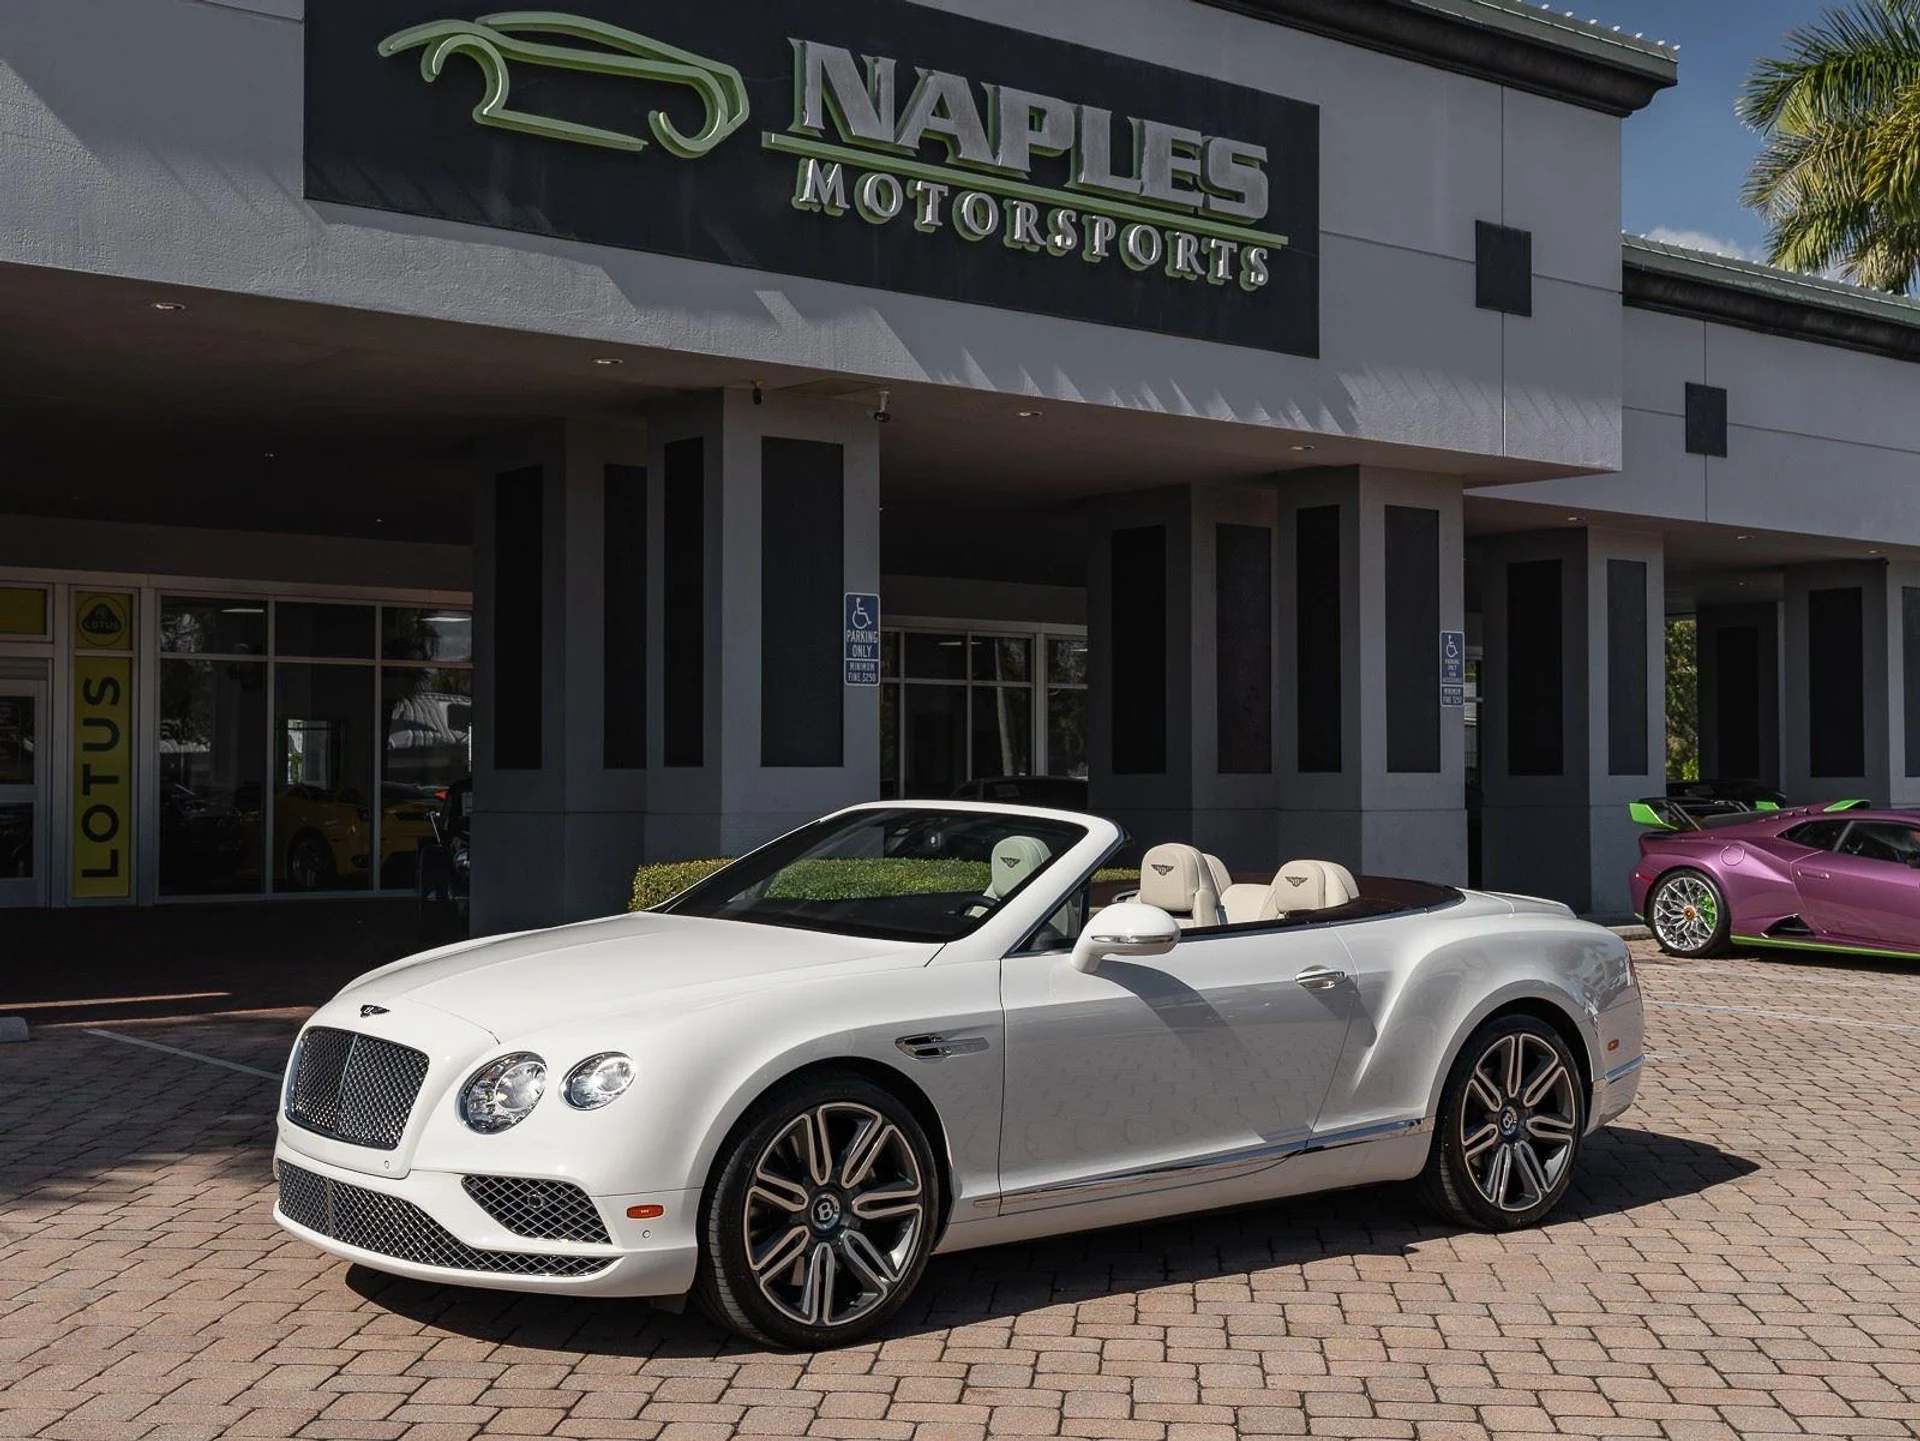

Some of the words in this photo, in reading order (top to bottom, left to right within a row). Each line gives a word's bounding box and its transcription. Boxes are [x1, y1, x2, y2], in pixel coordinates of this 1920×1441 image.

[788, 37, 1269, 220] NAPLES
[791, 158, 1269, 291] MOTORSPORTS
[846, 630, 878, 643] PARKING
[852, 644, 872, 658] ONLY
[82, 675, 120, 878] LOTUS
